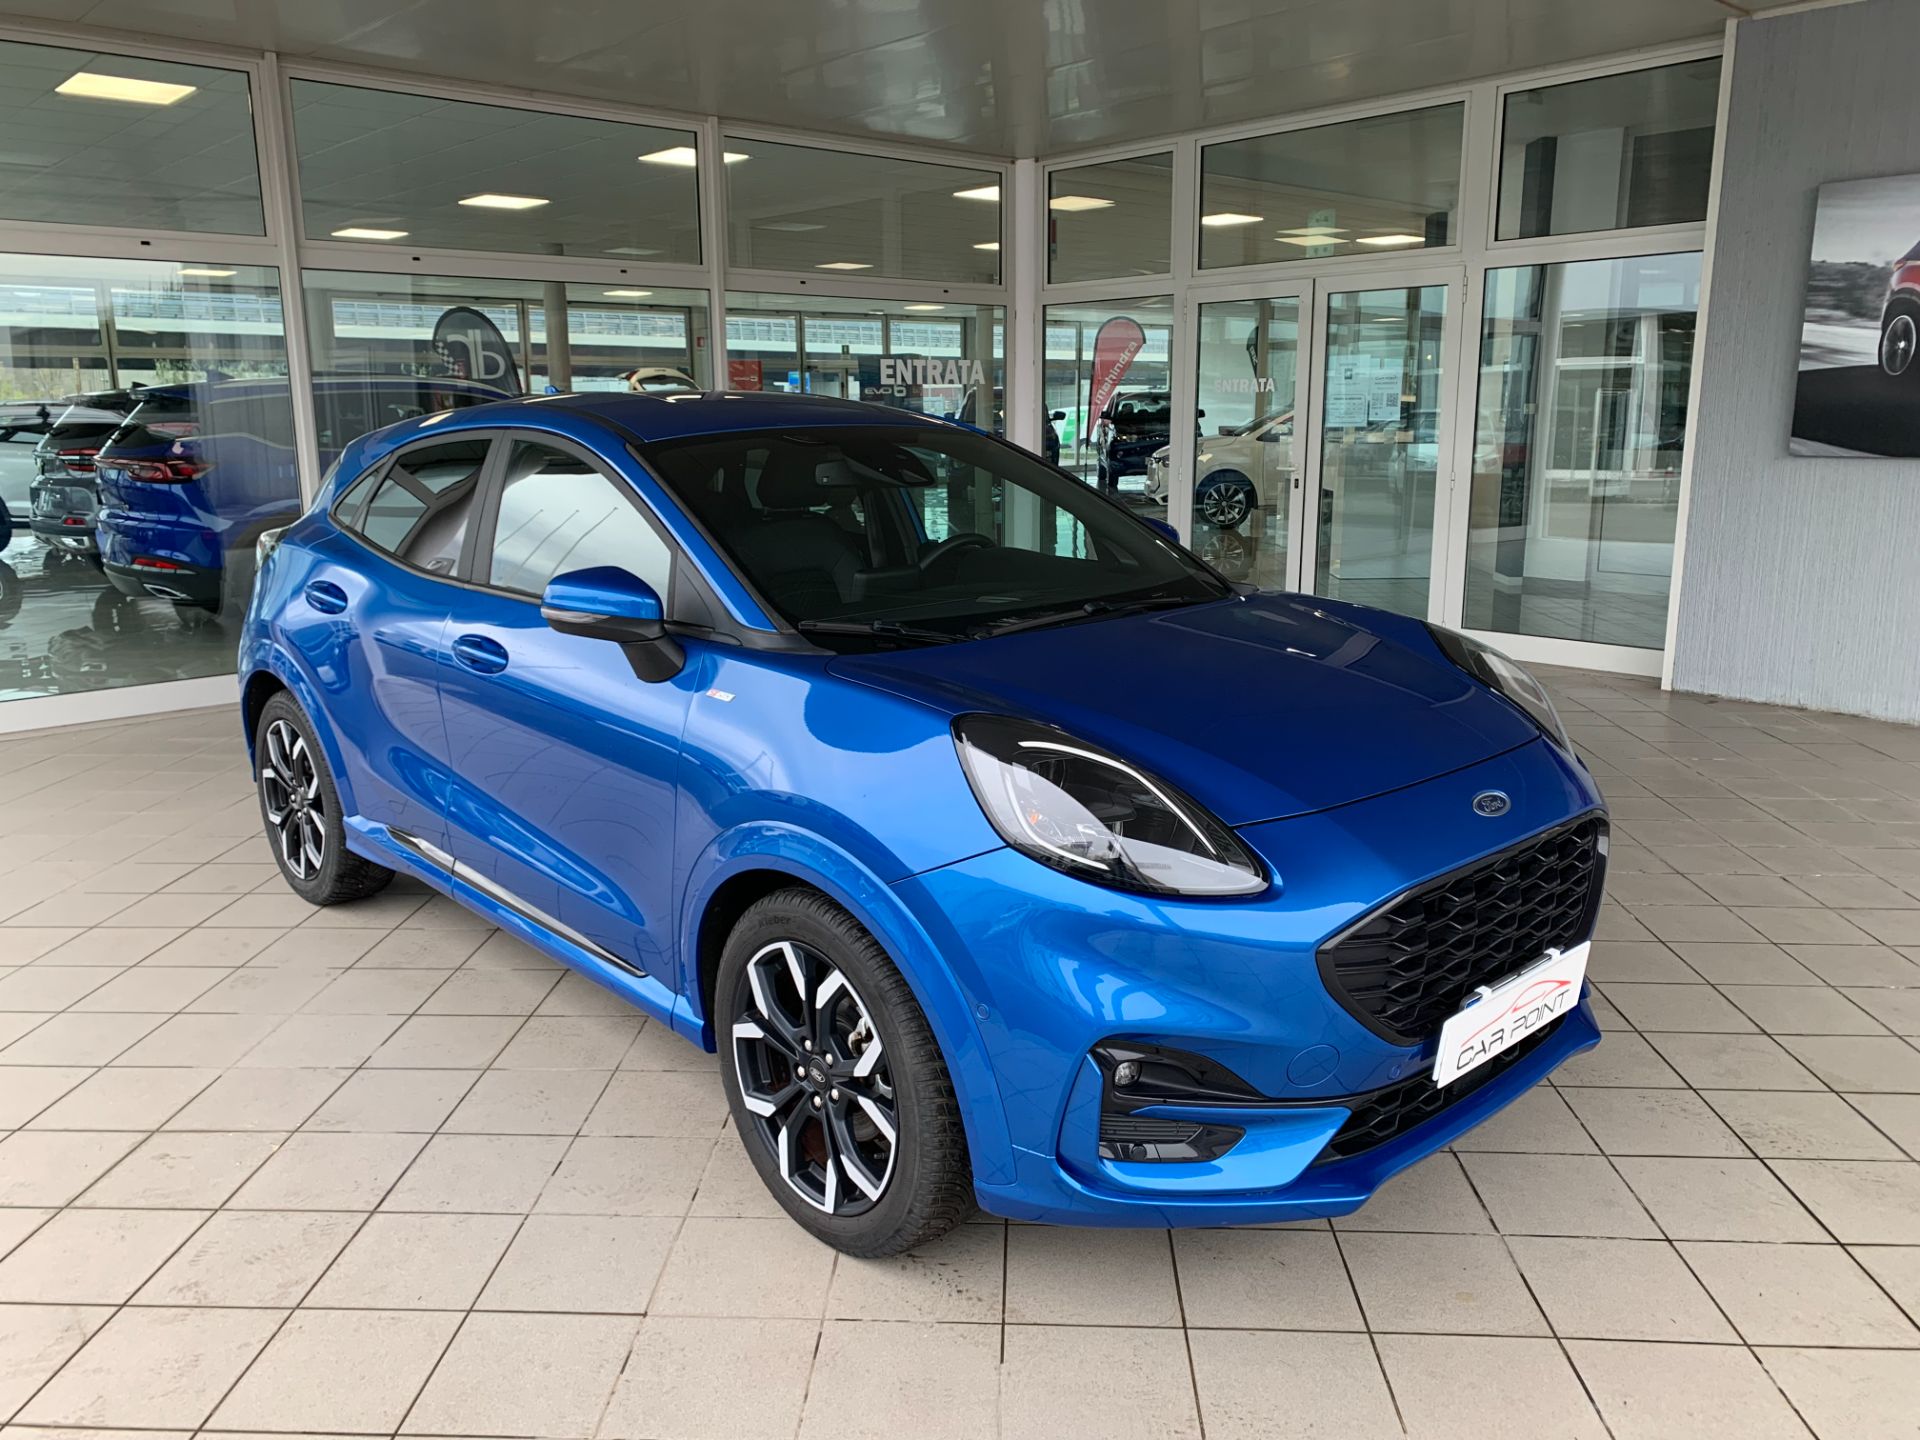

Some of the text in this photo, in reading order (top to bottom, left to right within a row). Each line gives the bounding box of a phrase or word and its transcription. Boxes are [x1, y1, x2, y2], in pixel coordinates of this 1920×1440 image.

[880, 359, 985, 384] ENTRATA
[1095, 341, 1138, 405] mahindra
[1215, 378, 1275, 393] ENTRATA
[1456, 989, 1570, 1071] CAR POINT
